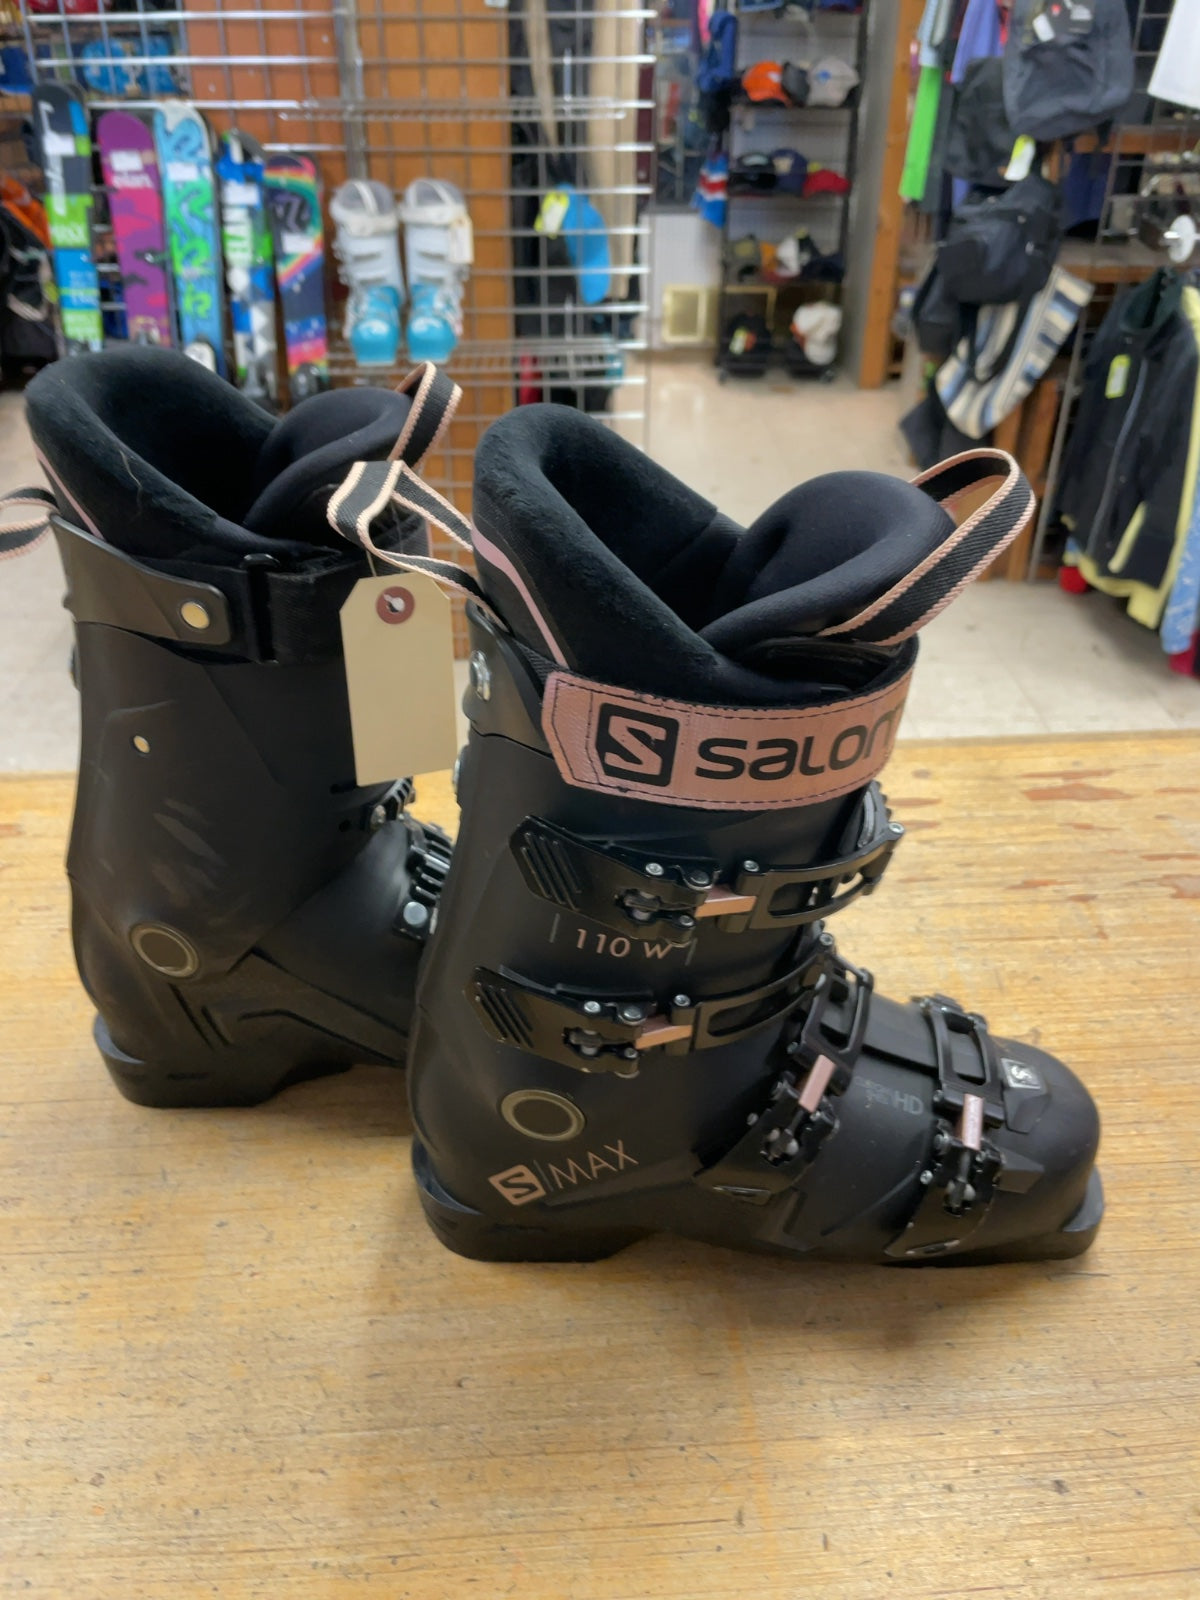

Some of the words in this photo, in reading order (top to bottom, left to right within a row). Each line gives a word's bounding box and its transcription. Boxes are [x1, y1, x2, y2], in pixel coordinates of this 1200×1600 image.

[577, 928, 631, 958] 110
[893, 1090, 925, 1116] HD
[547, 1139, 640, 1189] MAX
